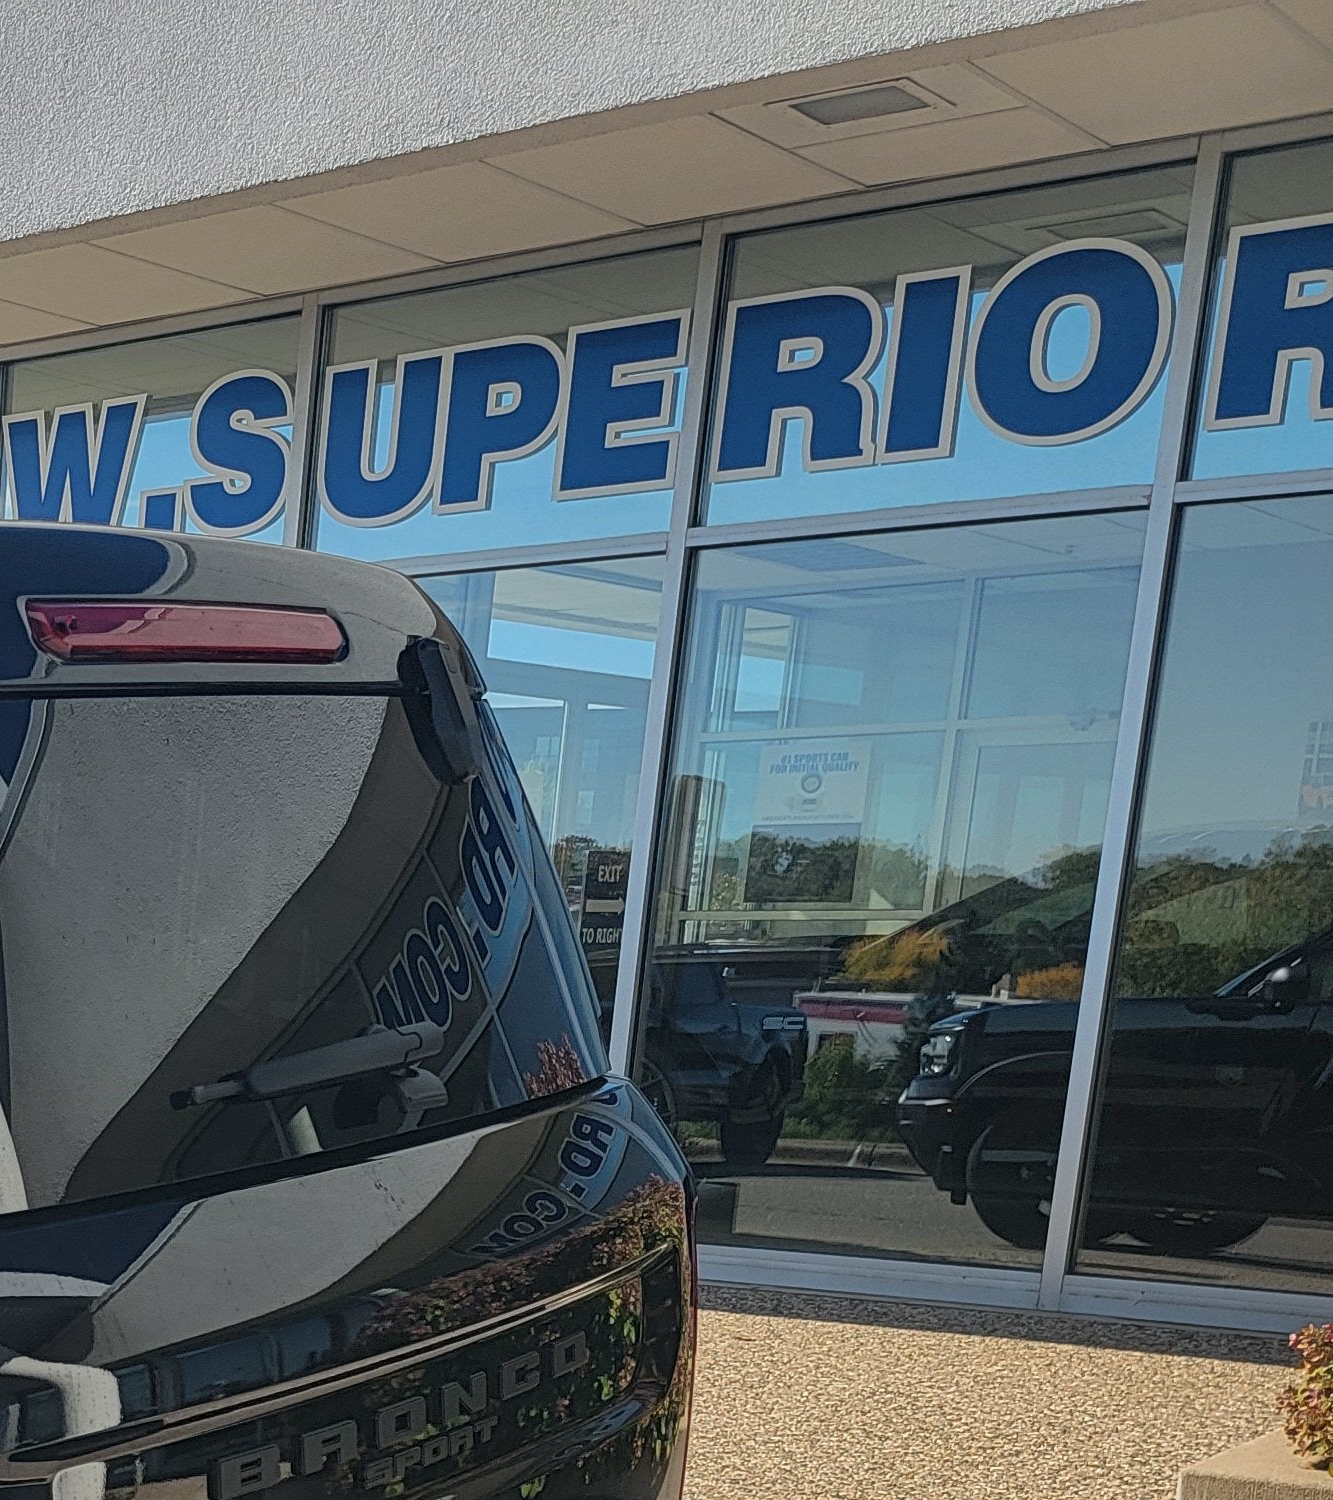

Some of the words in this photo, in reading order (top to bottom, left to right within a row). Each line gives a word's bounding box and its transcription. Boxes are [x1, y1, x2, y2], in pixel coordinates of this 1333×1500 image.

[793, 752, 829, 764] SPORTS
[821, 761, 860, 774] QUALITY
[598, 864, 623, 883] EXIT
[581, 927, 595, 944] TO
[595, 927, 623, 944] RIGH
[207, 1330, 590, 1500] BRONCO
[362, 1415, 499, 1490] SPORT
